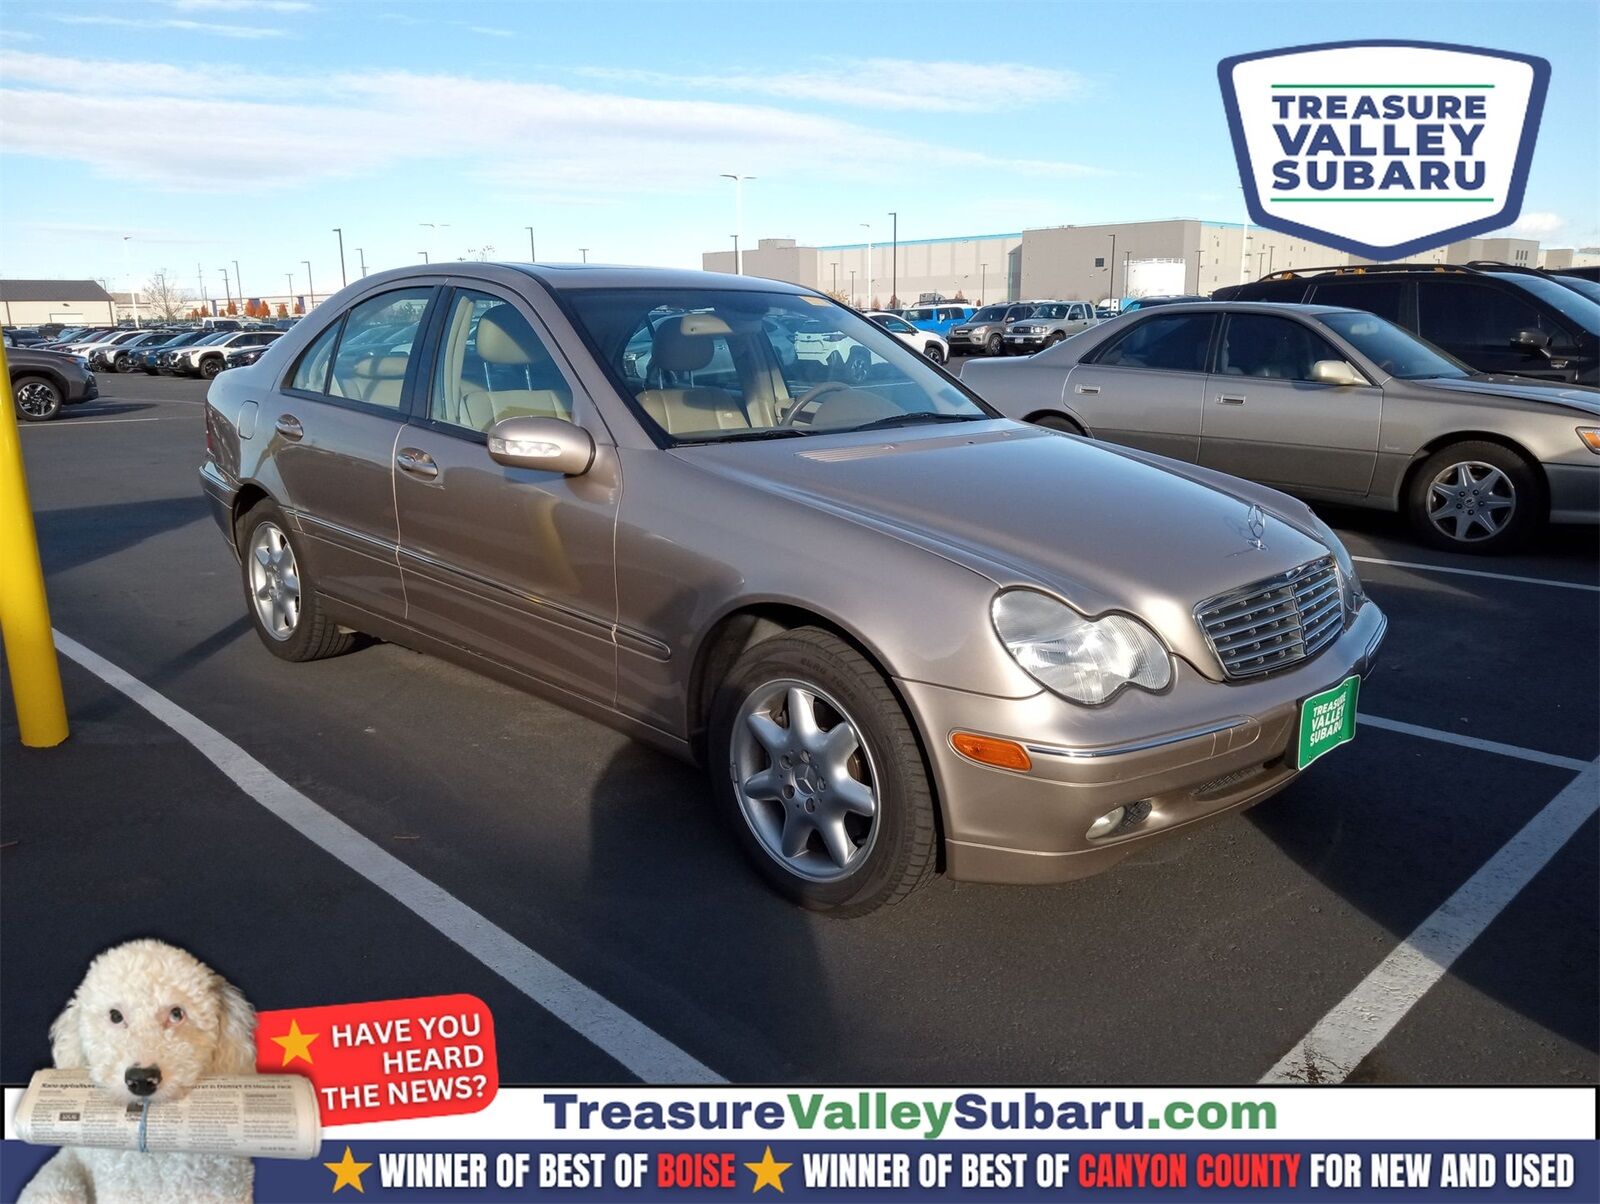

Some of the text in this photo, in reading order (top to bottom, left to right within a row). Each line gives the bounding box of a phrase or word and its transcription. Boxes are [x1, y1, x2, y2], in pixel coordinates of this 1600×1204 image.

[1311, 703, 1345, 732] VALLEY
[1313, 692, 1346, 717] TREASURE
[1309, 717, 1343, 747] SUBARU
